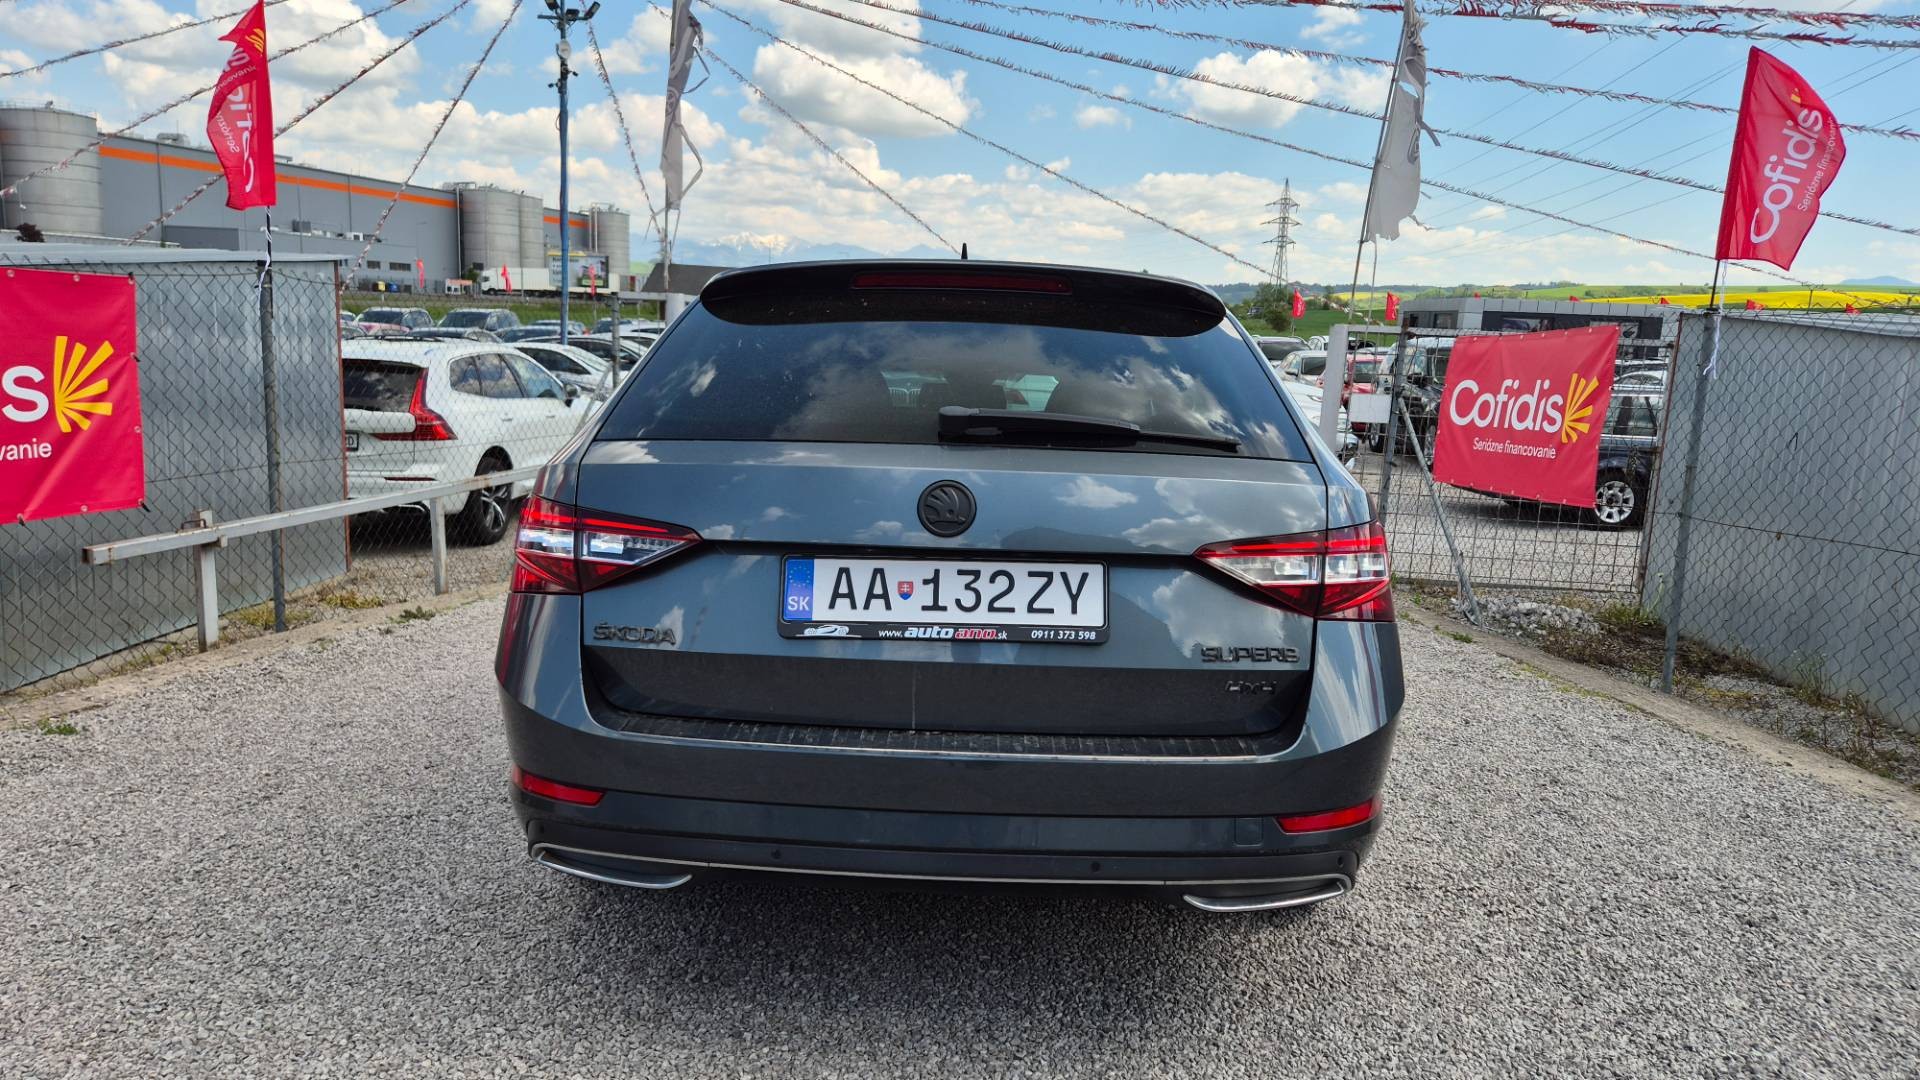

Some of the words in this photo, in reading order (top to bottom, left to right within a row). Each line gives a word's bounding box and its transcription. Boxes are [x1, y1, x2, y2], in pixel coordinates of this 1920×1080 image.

[1750, 108, 1823, 244] Cofidis
[1450, 378, 1564, 433] Cofidis
[1473, 437, 1503, 452] Seriózne
[1504, 440, 1556, 459] financovanie
[787, 596, 810, 611] SK
[593, 619, 676, 646] ŠKODA
[1031, 629, 1054, 640] 0911
[1057, 630, 1075, 640] 373
[1078, 631, 1096, 641] 598
[1201, 646, 1300, 663] SUPERB
